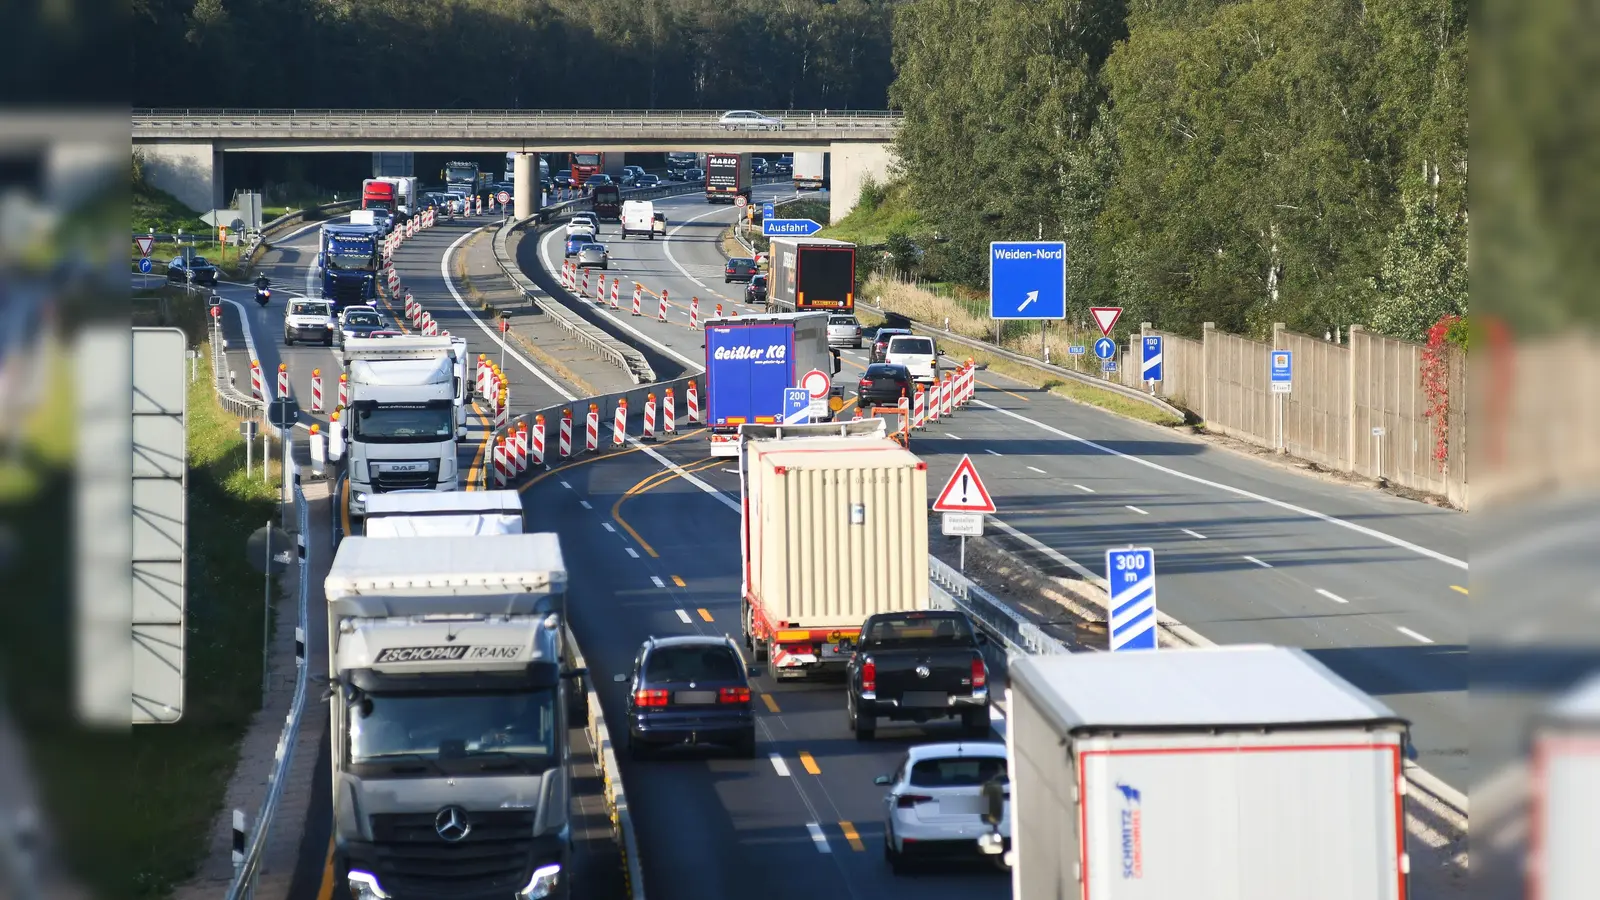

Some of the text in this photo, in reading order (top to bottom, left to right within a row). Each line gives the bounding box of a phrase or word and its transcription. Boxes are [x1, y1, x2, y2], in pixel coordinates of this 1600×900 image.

[768, 223, 808, 232] Ausfahrt
[995, 249, 1062, 259] Weiden-Nord
[1146, 338, 1158, 346] 100
[714, 345, 786, 360] Geißler KG
[789, 391, 806, 401] 200
[1116, 553, 1145, 570] 300
[1124, 572, 1138, 582] m
[379, 646, 519, 663] ZSCHOPAU TRANS
[1122, 808, 1134, 880] SCHMITZ
